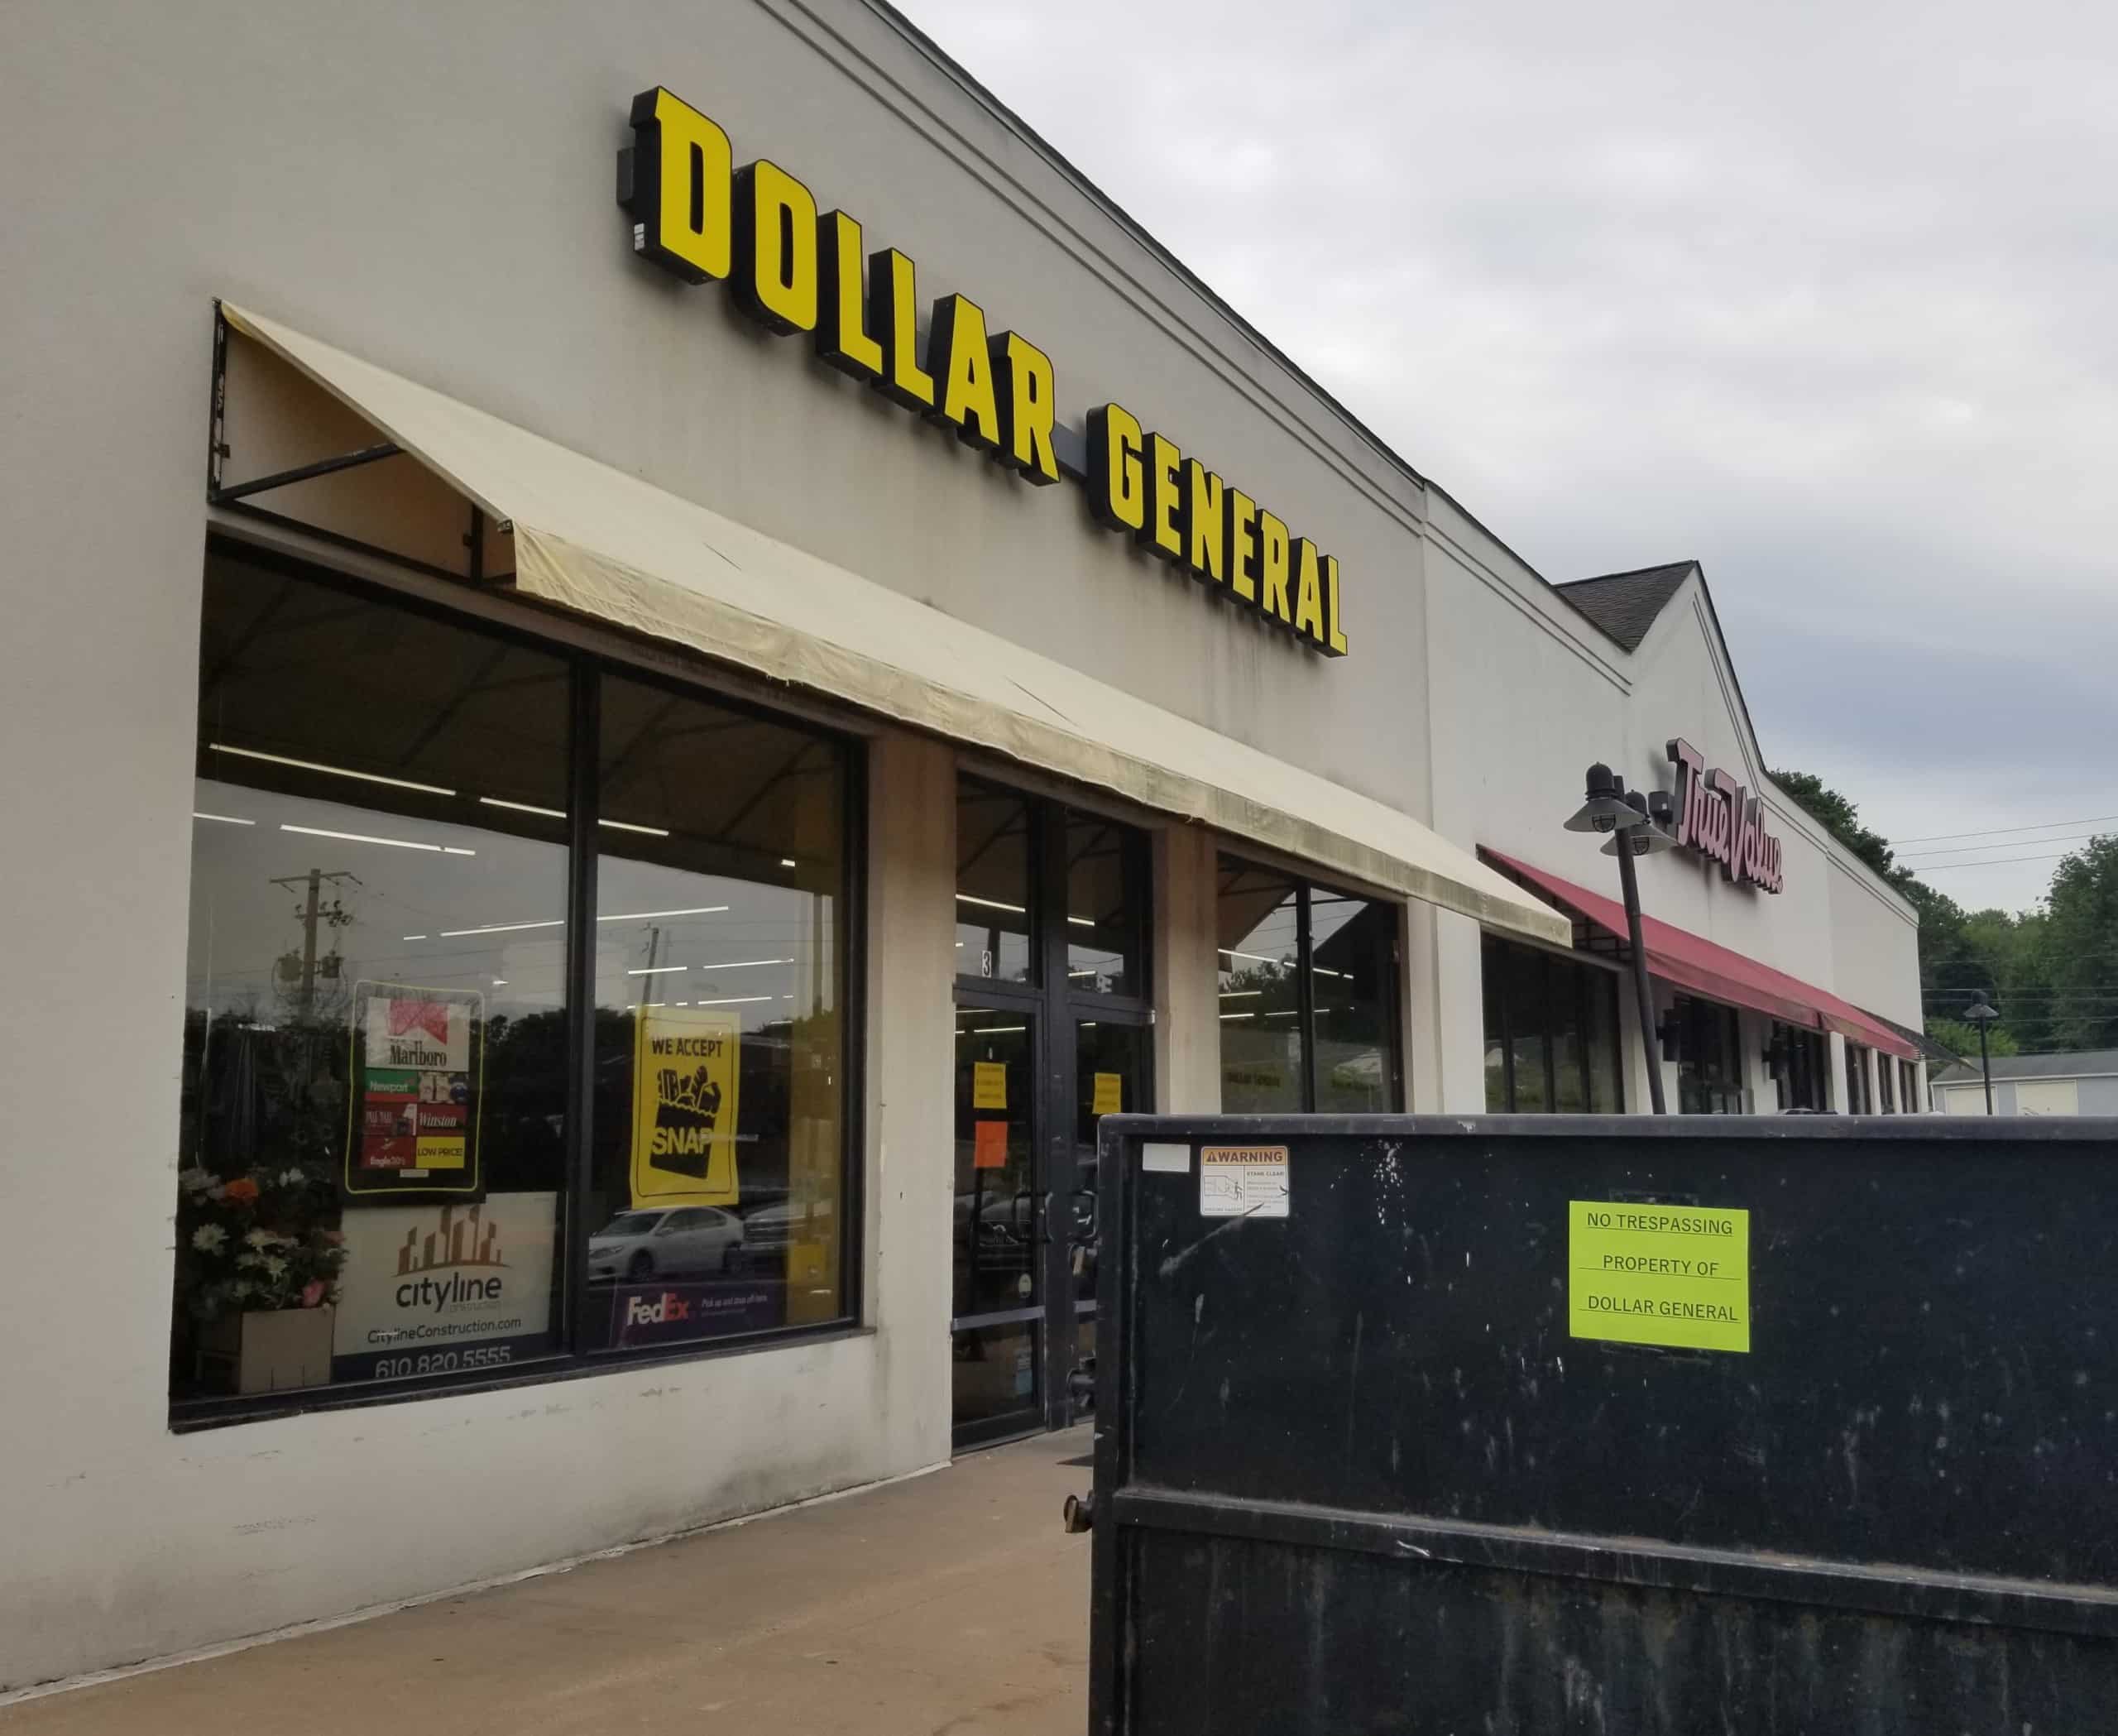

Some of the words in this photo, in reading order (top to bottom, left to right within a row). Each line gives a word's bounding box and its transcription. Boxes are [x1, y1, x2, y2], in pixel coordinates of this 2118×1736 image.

[654, 85, 1061, 484] DOLLAR
[1104, 402, 1349, 657] GENERAL
[1673, 737, 1729, 864] True
[1713, 768, 1784, 894] Value
[984, 952, 991, 976] 3
[389, 1040, 448, 1067] Marlboro
[651, 1039, 673, 1056] WE
[675, 1038, 724, 1059] ACCEPT
[369, 1080, 410, 1093] Newport
[419, 1112, 458, 1127] Winston
[418, 1147, 437, 1157] LOW
[438, 1147, 464, 1157] PRICE
[652, 1127, 713, 1156] SNAP
[1217, 1151, 1283, 1163] WARNING
[1587, 1212, 1612, 1227] NO
[1616, 1214, 1733, 1235] TRESPASSING
[1603, 1254, 1692, 1274] PROPERTY
[1696, 1261, 1720, 1276] OF
[395, 1271, 503, 1313] cityline
[625, 1292, 690, 1326] FedEx
[1588, 1295, 1654, 1314] DOLLAR
[1659, 1300, 1739, 1321] GENERAL
[367, 1318, 521, 1345] CitylineConstruction.com
[375, 1356, 412, 1379] 610
[416, 1351, 458, 1374] 820
[462, 1345, 511, 1368] 5555
